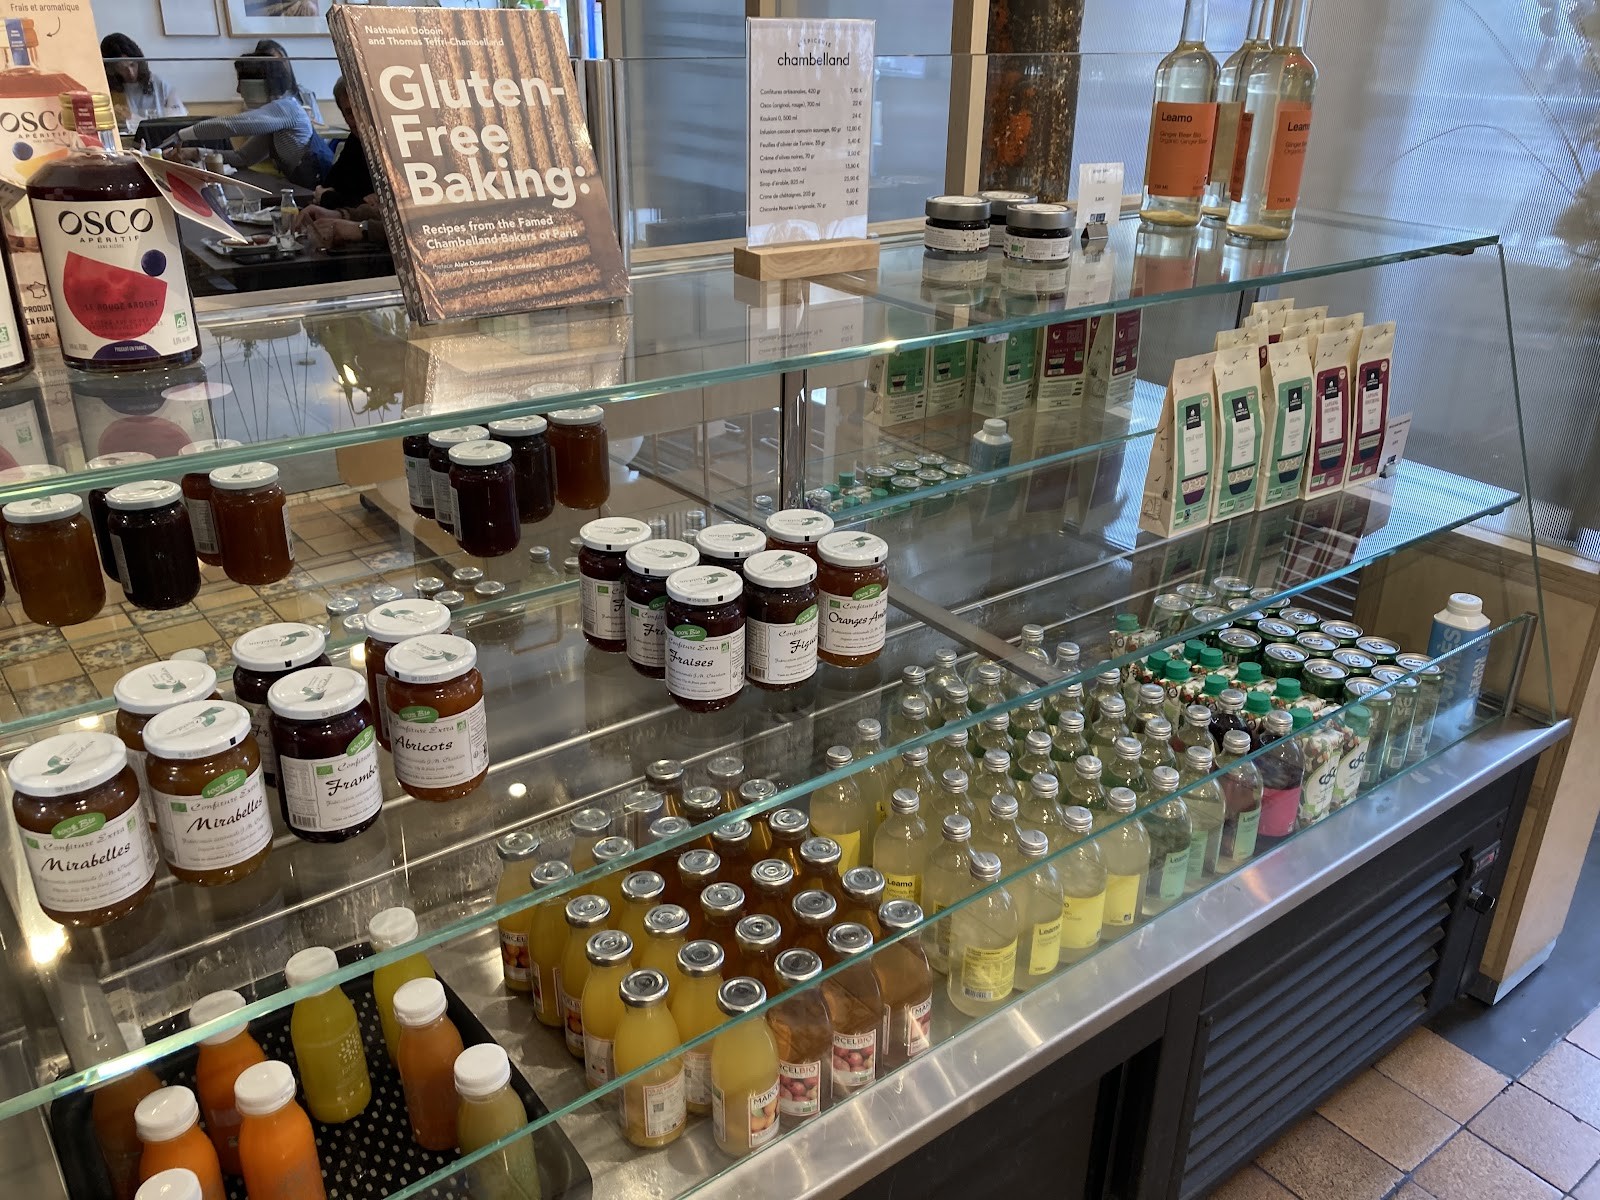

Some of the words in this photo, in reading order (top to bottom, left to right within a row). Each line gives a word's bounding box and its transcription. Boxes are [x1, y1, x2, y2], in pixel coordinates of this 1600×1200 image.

[40, 4, 80, 12] aromatique
[365, 26, 409, 34] Nathaniel
[410, 26, 443, 35] Doboin
[368, 37, 385, 45] and
[387, 37, 423, 46] Thomas
[777, 52, 850, 66] chambelland
[379, 63, 564, 110] Gluten-
[0, 111, 63, 132] OSC
[1162, 112, 1192, 122] Leamo
[391, 114, 510, 158] Free
[404, 158, 590, 208] Baking:
[58, 208, 153, 235] OSCO
[422, 224, 466, 236] Recipes
[468, 221, 495, 231] from
[498, 218, 515, 229] the
[518, 216, 554, 228] Famed
[80, 235, 140, 243] APÉRITIF
[426, 234, 498, 250] Chambelland
[500, 232, 536, 243] Bakers
[540, 230, 550, 240] of
[552, 228, 578, 238] Paris
[24, 304, 52, 313] PRODUIT
[828, 612, 867, 628] Oranges
[670, 649, 714, 667] Fraises
[395, 736, 453, 751] Abricots
[206, 783, 225, 795] 100%
[226, 774, 240, 785] Bio
[191, 796, 237, 812] Confiture
[79, 817, 96, 827] Bio
[187, 795, 263, 833] Mirabelles
[43, 841, 94, 852] Confiture
[97, 827, 125, 842] Extra
[41, 842, 131, 872] Mirabelles
[887, 878, 912, 887] Leamo
